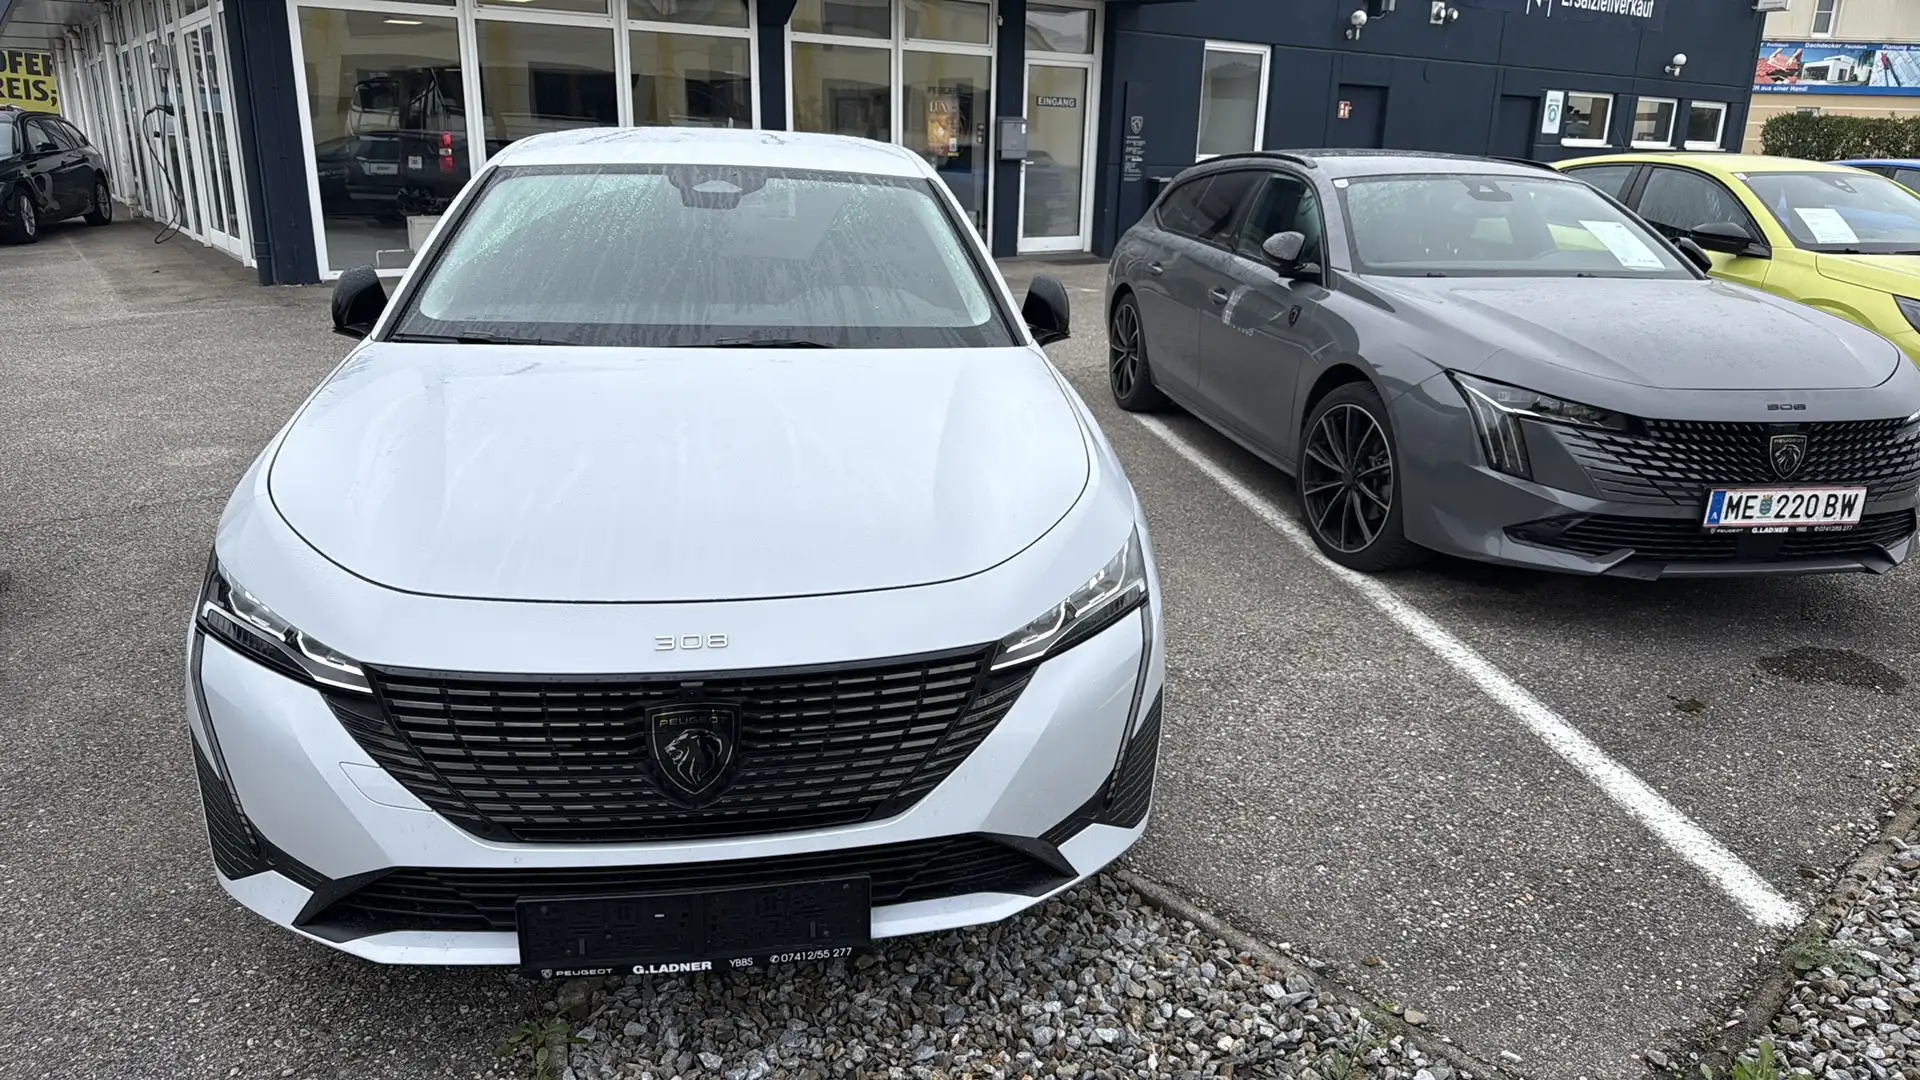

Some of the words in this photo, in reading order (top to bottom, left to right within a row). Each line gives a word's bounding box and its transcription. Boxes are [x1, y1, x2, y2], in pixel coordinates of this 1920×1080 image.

[1037, 97, 1075, 107] EINGANG
[1724, 495, 1758, 520] ME
[1774, 494, 1820, 519] 220
[1823, 493, 1859, 518] BW
[1710, 512, 1718, 520] A
[654, 633, 729, 651] 308
[556, 968, 613, 977] PEUGEOT
[632, 960, 712, 975] G.LADNER
[729, 957, 754, 969] YBBS
[781, 949, 830, 963] 07412/55
[832, 946, 852, 957] 277
